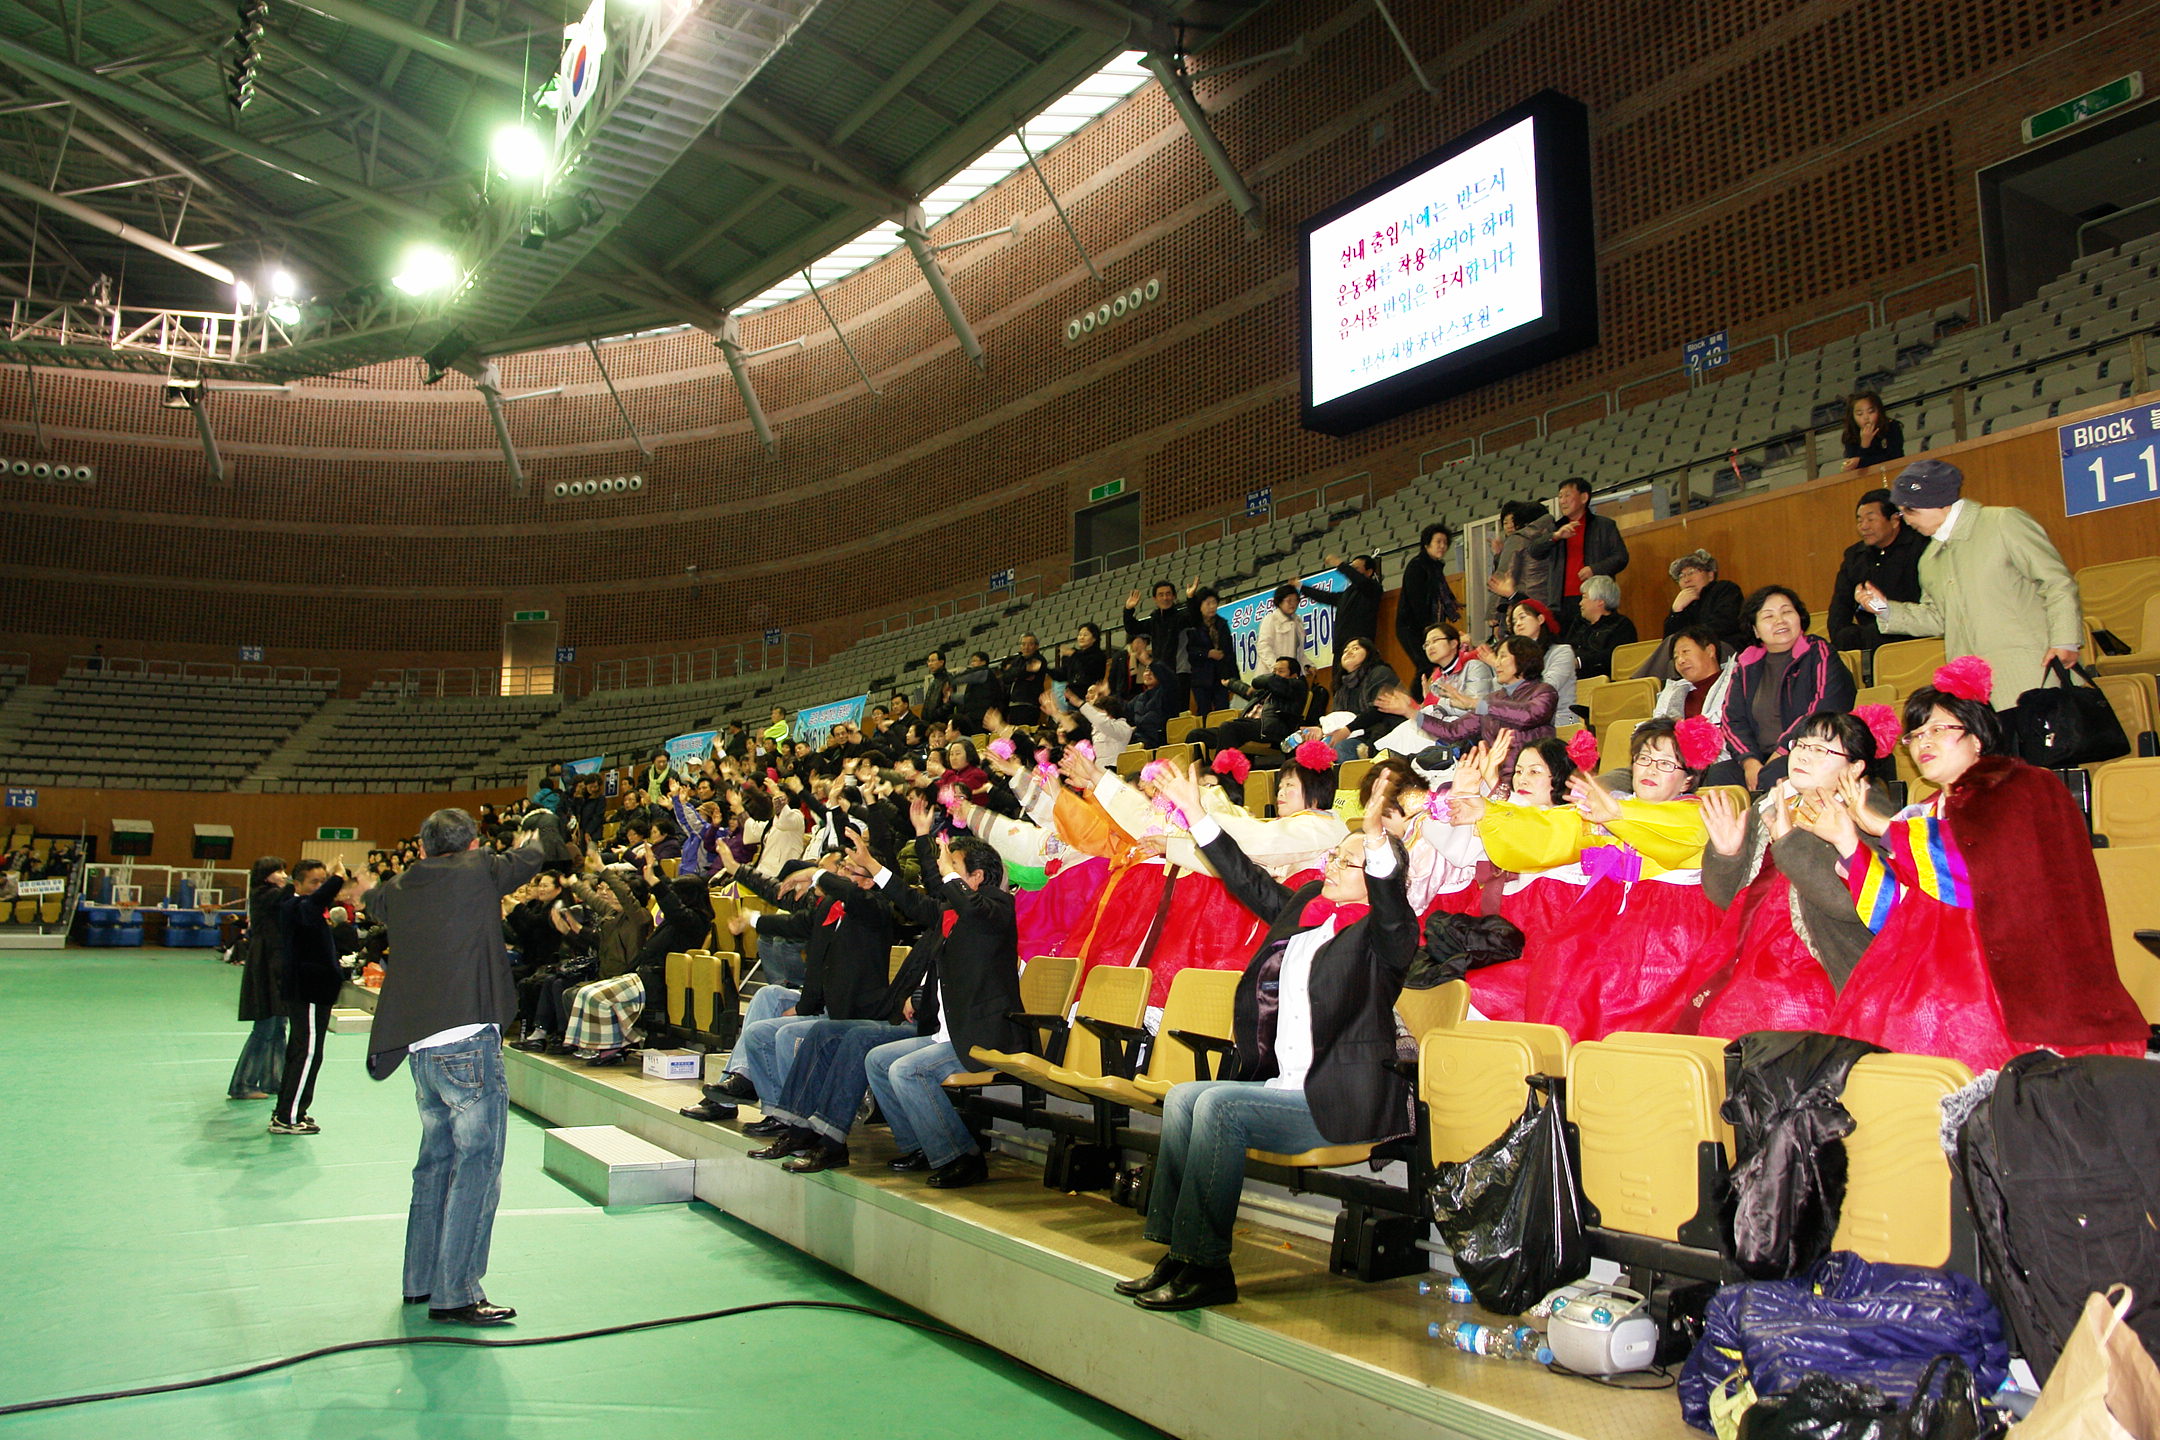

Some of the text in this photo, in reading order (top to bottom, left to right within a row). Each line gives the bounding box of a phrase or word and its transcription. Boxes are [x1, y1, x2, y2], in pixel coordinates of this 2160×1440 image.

[1340, 238, 1365, 269] 실내
[1457, 167, 1506, 211] 반드시
[1336, 203, 1514, 307] 운동화를 착용하여야 하며
[1433, 242, 1516, 300] 금지합니다
[2074, 417, 2135, 448] Block
[2088, 444, 2158, 503] 1-1
[11, 795, 33, 807] 1-6
